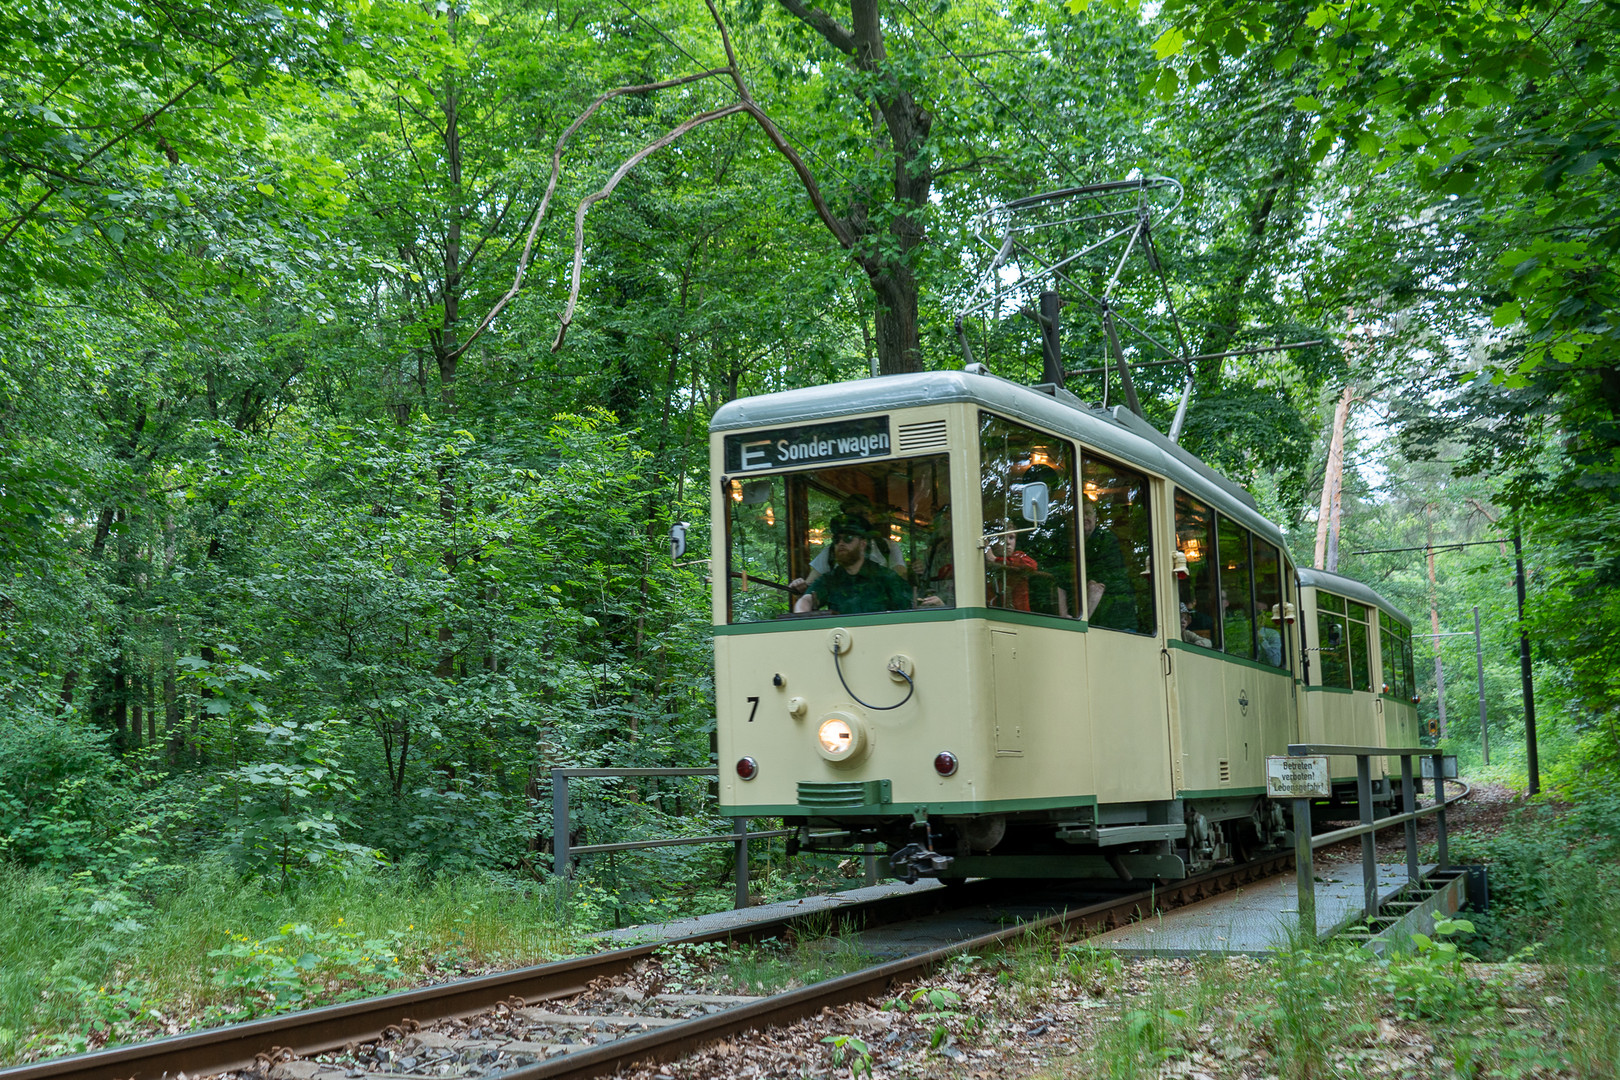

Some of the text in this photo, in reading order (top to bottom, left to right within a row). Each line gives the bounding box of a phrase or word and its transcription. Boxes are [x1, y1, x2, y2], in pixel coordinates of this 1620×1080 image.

[741, 433, 889, 470] E Sonderwagen
[747, 696, 760, 722] 7
[1283, 761, 1313, 770] Betreten
[1282, 771, 1315, 781] verboten!
